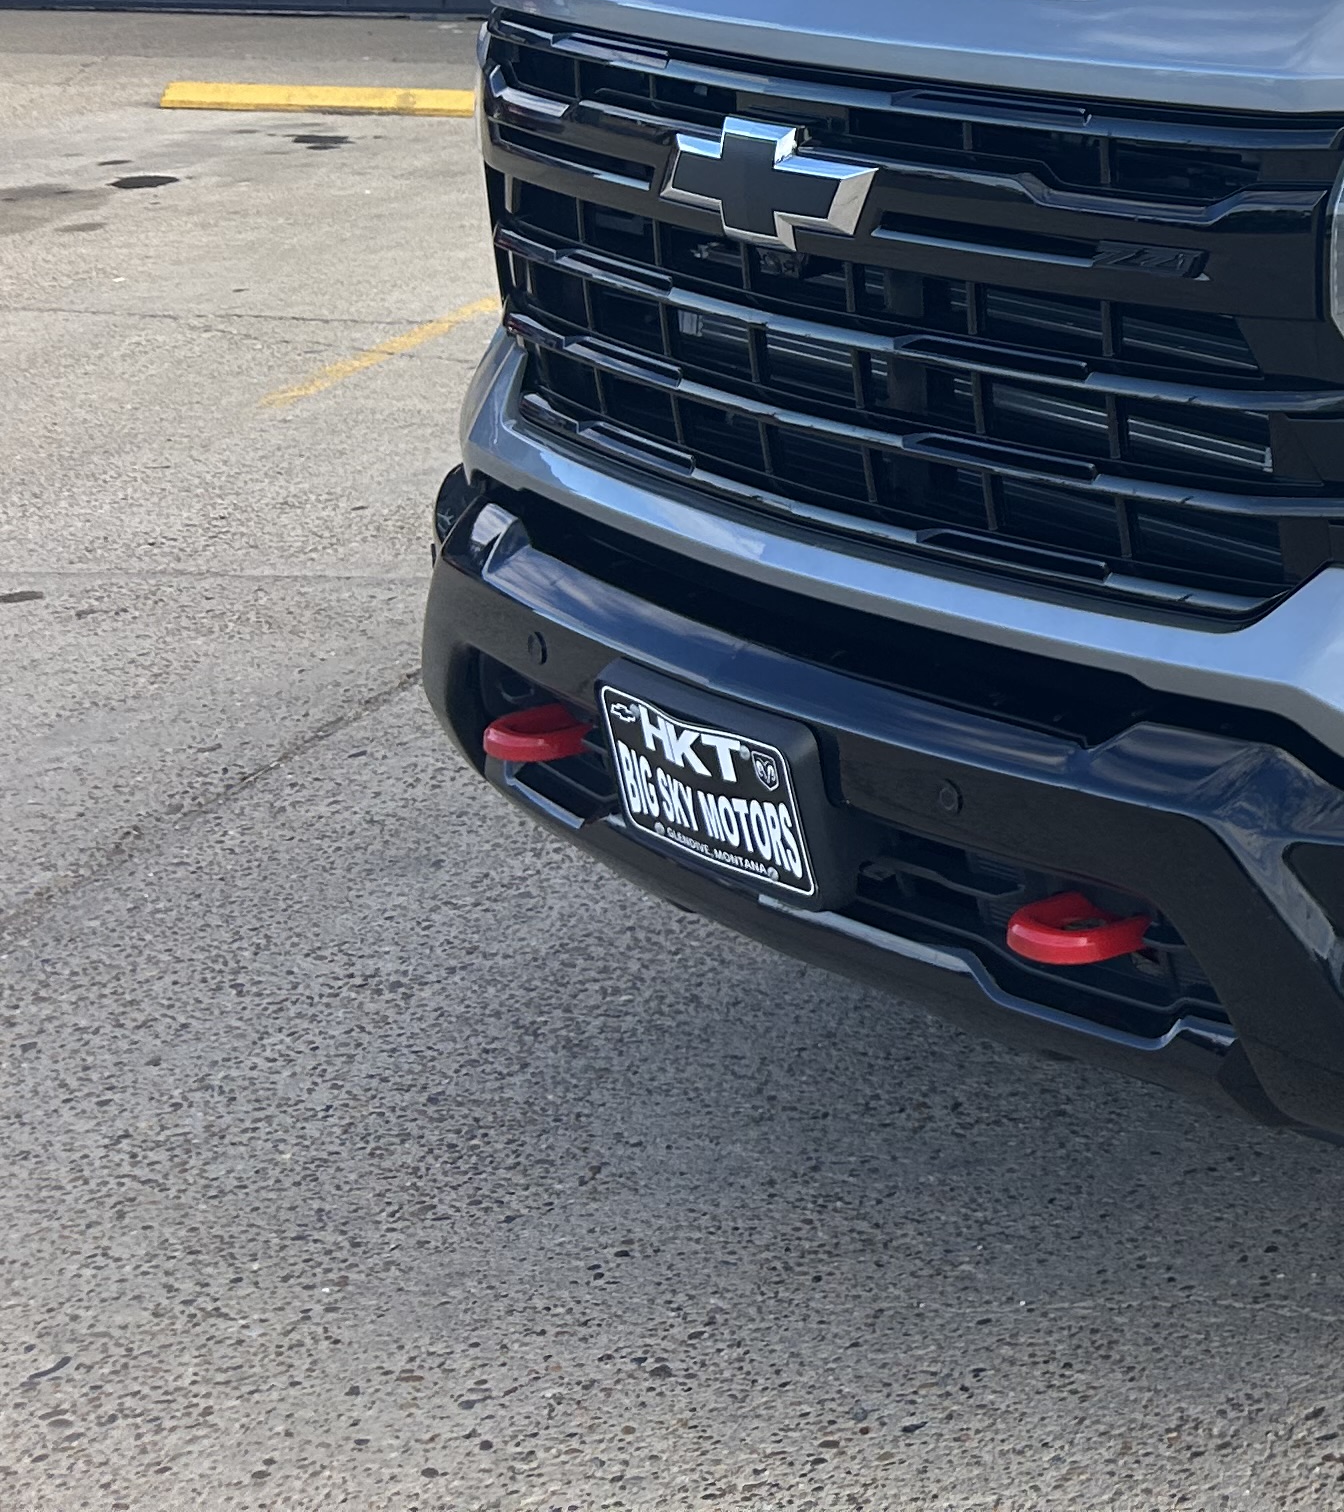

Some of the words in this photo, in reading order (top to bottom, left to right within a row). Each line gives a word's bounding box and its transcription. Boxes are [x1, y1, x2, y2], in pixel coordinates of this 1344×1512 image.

[636, 704, 741, 783] HKT
[617, 740, 660, 818] BIG
[655, 766, 699, 832] SKY
[696, 790, 803, 879] MOTORS
[666, 827, 715, 858] GLENDIVE,
[713, 848, 768, 876] MONTANA
